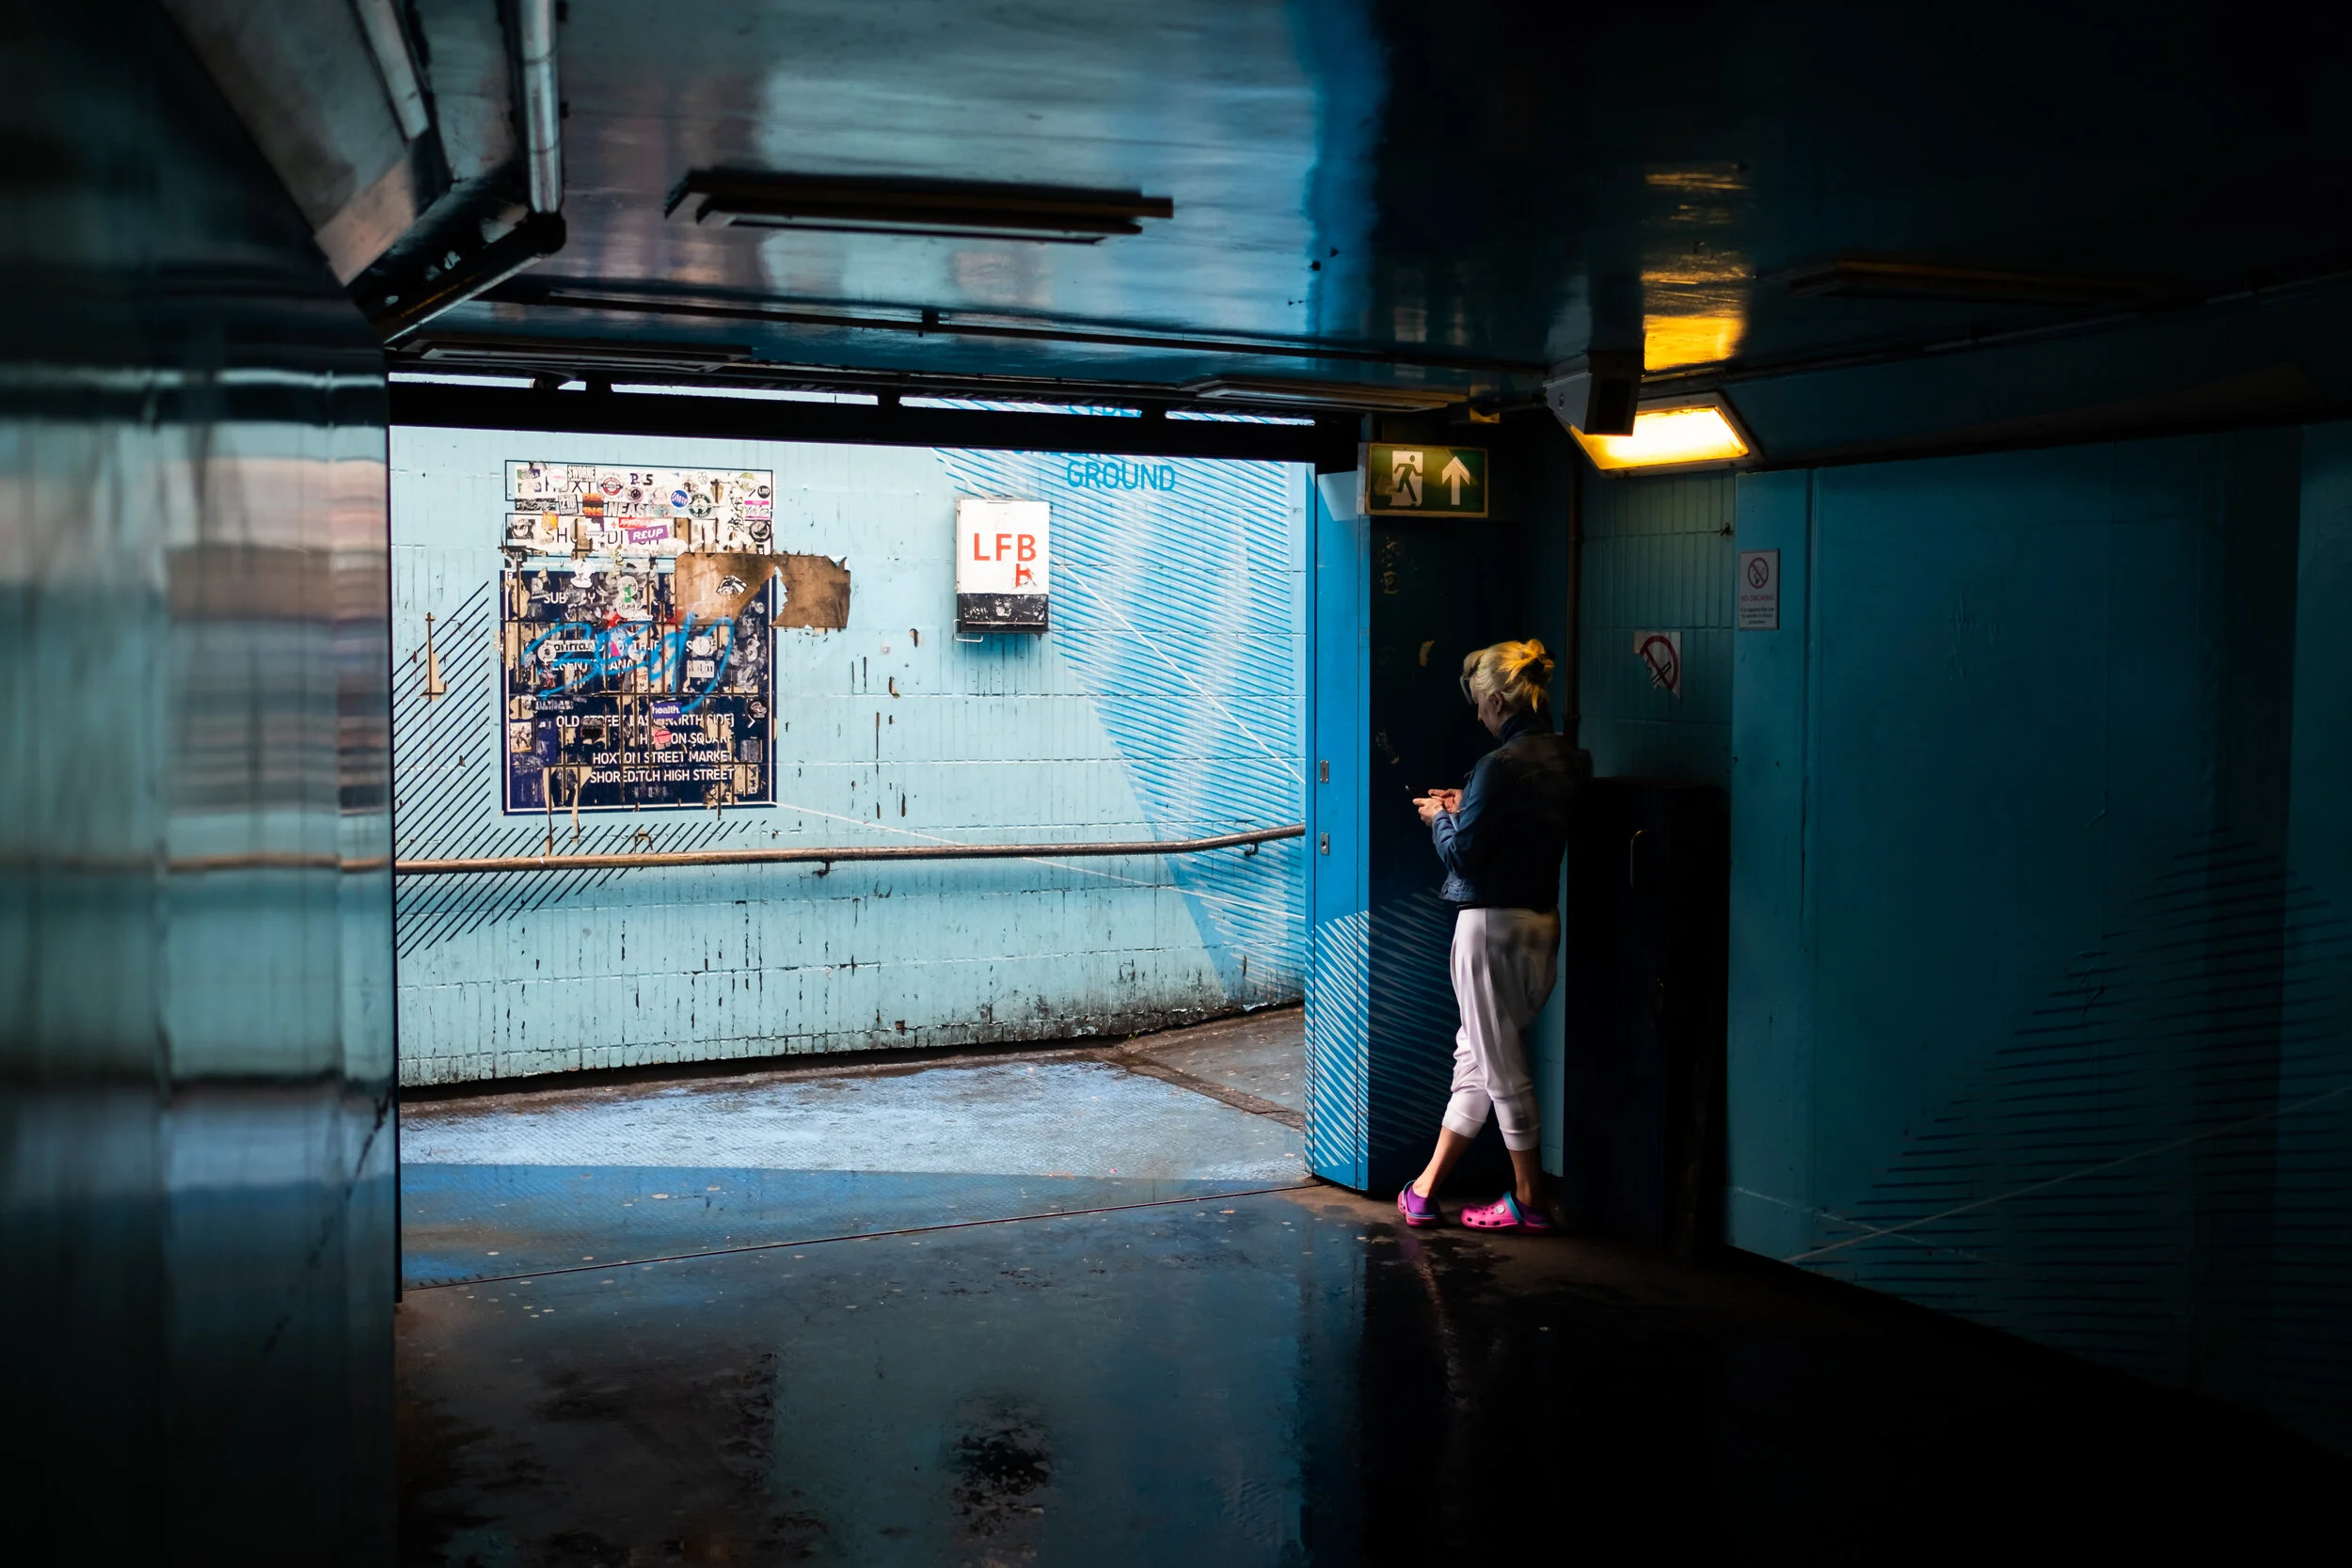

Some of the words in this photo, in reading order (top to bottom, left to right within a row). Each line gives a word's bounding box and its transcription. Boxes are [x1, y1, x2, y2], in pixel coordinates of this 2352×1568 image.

[1067, 461, 1175, 491] GROUND
[974, 532, 1037, 562] LFB
[543, 592, 596, 604] SUBY
[652, 705, 680, 714] health.
[556, 715, 580, 727] OLD
[592, 752, 641, 765] HOXTON
[644, 751, 685, 764] STREET
[689, 750, 733, 763] MARKET
[591, 769, 660, 784] SHOREDITCH
[663, 769, 690, 783] HIGH
[692, 768, 735, 781] STREET
